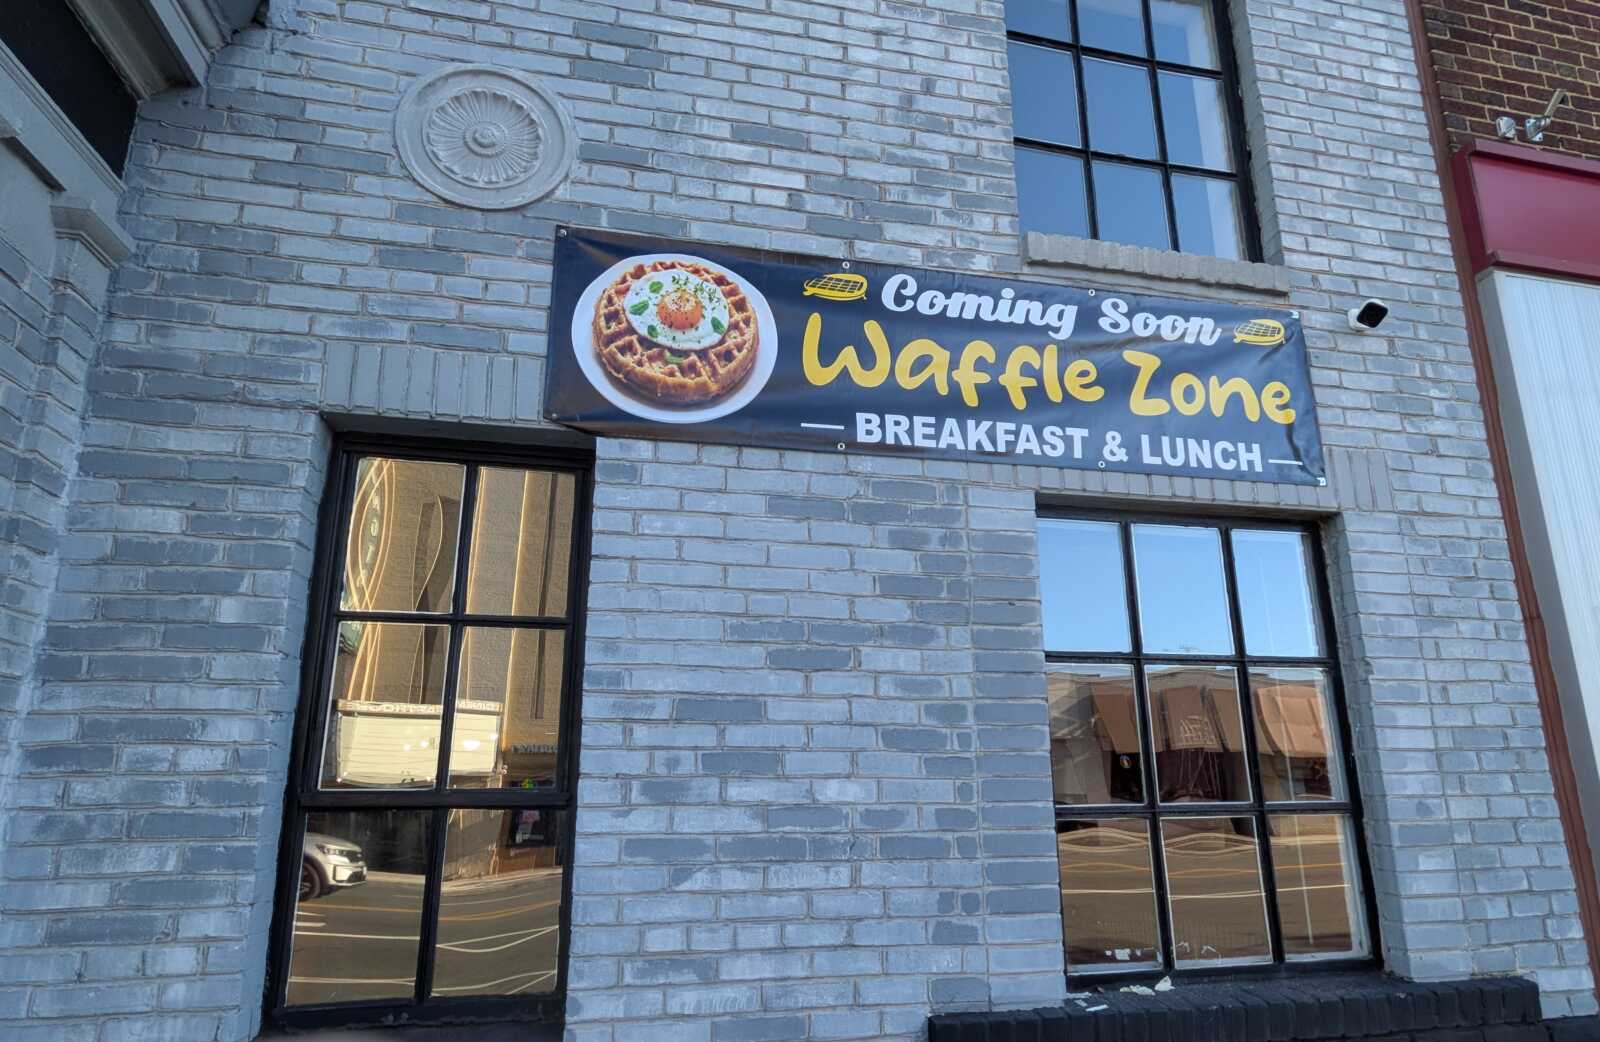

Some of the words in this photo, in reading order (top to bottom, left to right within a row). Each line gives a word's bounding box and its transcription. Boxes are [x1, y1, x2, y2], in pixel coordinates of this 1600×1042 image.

[881, 274, 1078, 341] Coming
[1098, 298, 1222, 346] Soon
[802, 312, 1105, 410] Waffle
[1123, 350, 1296, 424] Zone
[855, 412, 1089, 460] BREAKFAST
[1103, 430, 1129, 463] &
[1141, 434, 1263, 473] LUNCH
